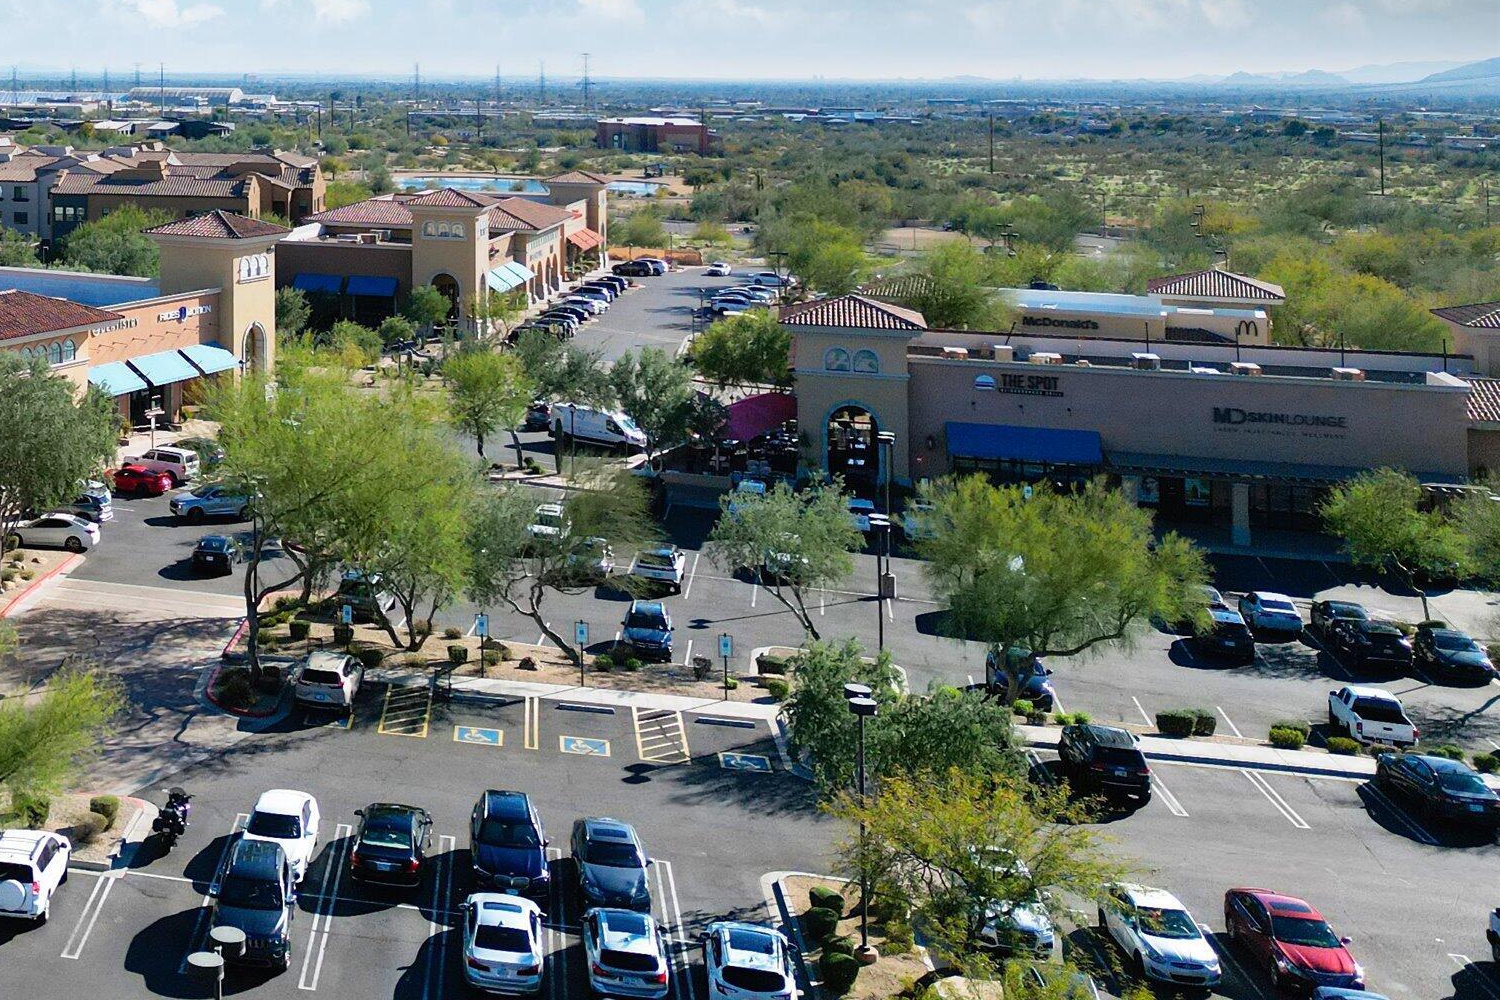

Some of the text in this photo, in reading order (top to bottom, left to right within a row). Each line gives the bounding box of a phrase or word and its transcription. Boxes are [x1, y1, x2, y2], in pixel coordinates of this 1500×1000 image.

[1022, 316, 1099, 330] McDonald's
[1001, 374, 1059, 390] THE SPOT
